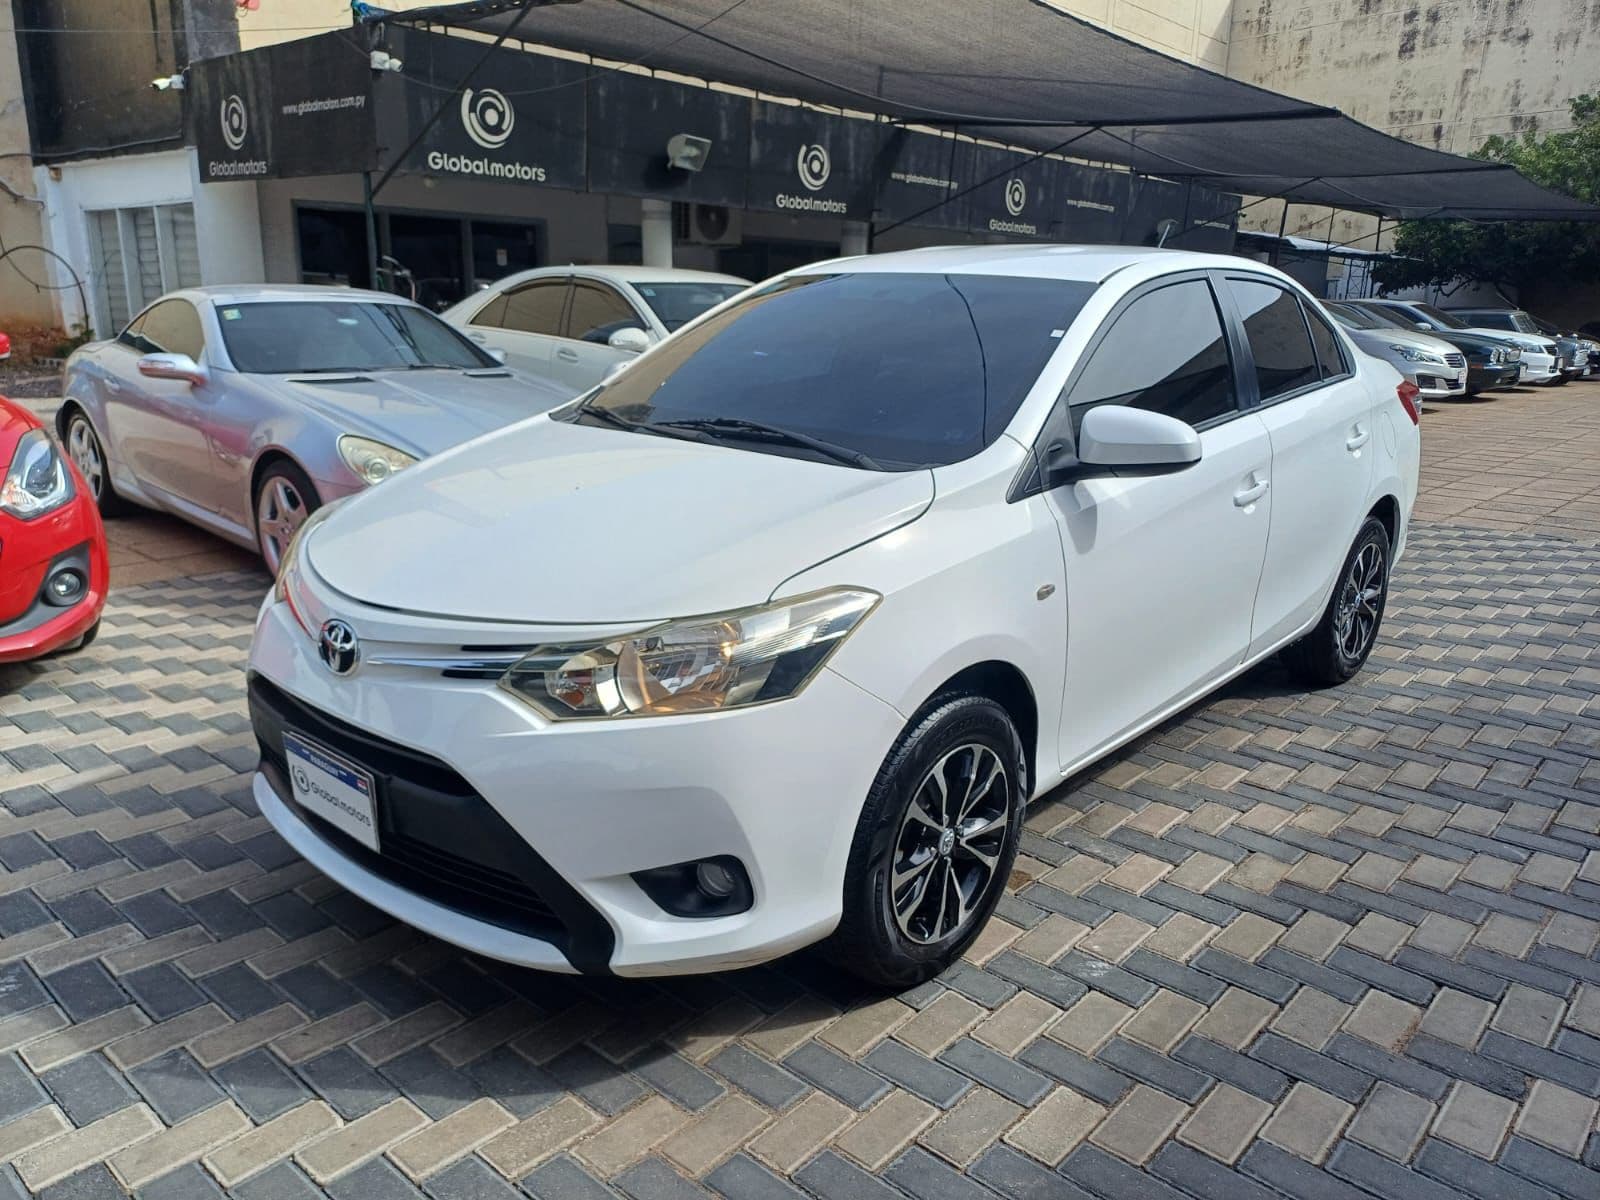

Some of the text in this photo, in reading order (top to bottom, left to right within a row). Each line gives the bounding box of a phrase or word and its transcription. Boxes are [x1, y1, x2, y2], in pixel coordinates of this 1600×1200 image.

[209, 159, 268, 177] Globalmotors
[427, 151, 547, 182] Globalmotors
[775, 193, 848, 214] Globalmotors
[989, 218, 1037, 235] Globalmotors
